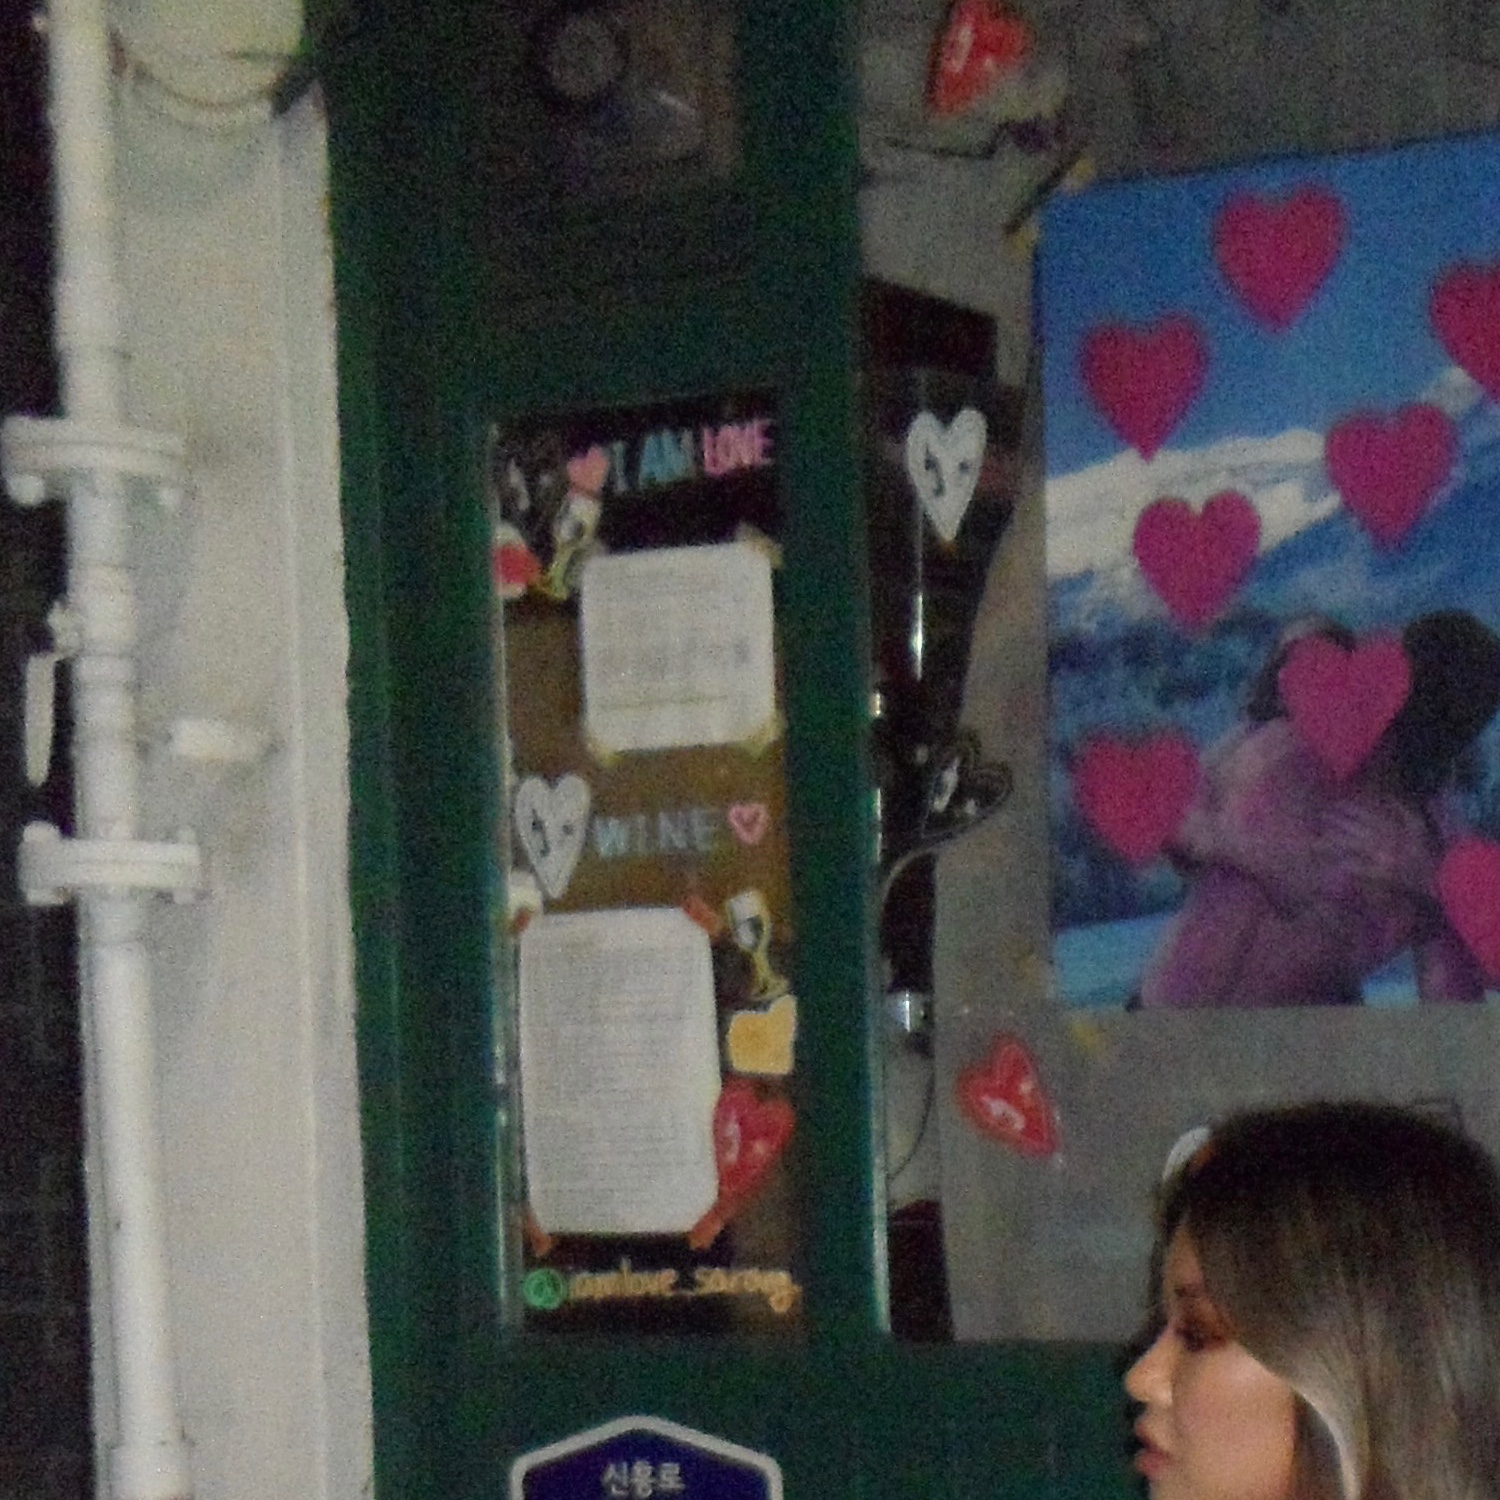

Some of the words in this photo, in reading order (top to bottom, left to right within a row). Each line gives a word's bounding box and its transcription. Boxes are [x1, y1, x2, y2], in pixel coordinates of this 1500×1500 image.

[638, 427, 696, 490] AM
[702, 418, 774, 477] LOVE
[594, 807, 716, 858] WINE
